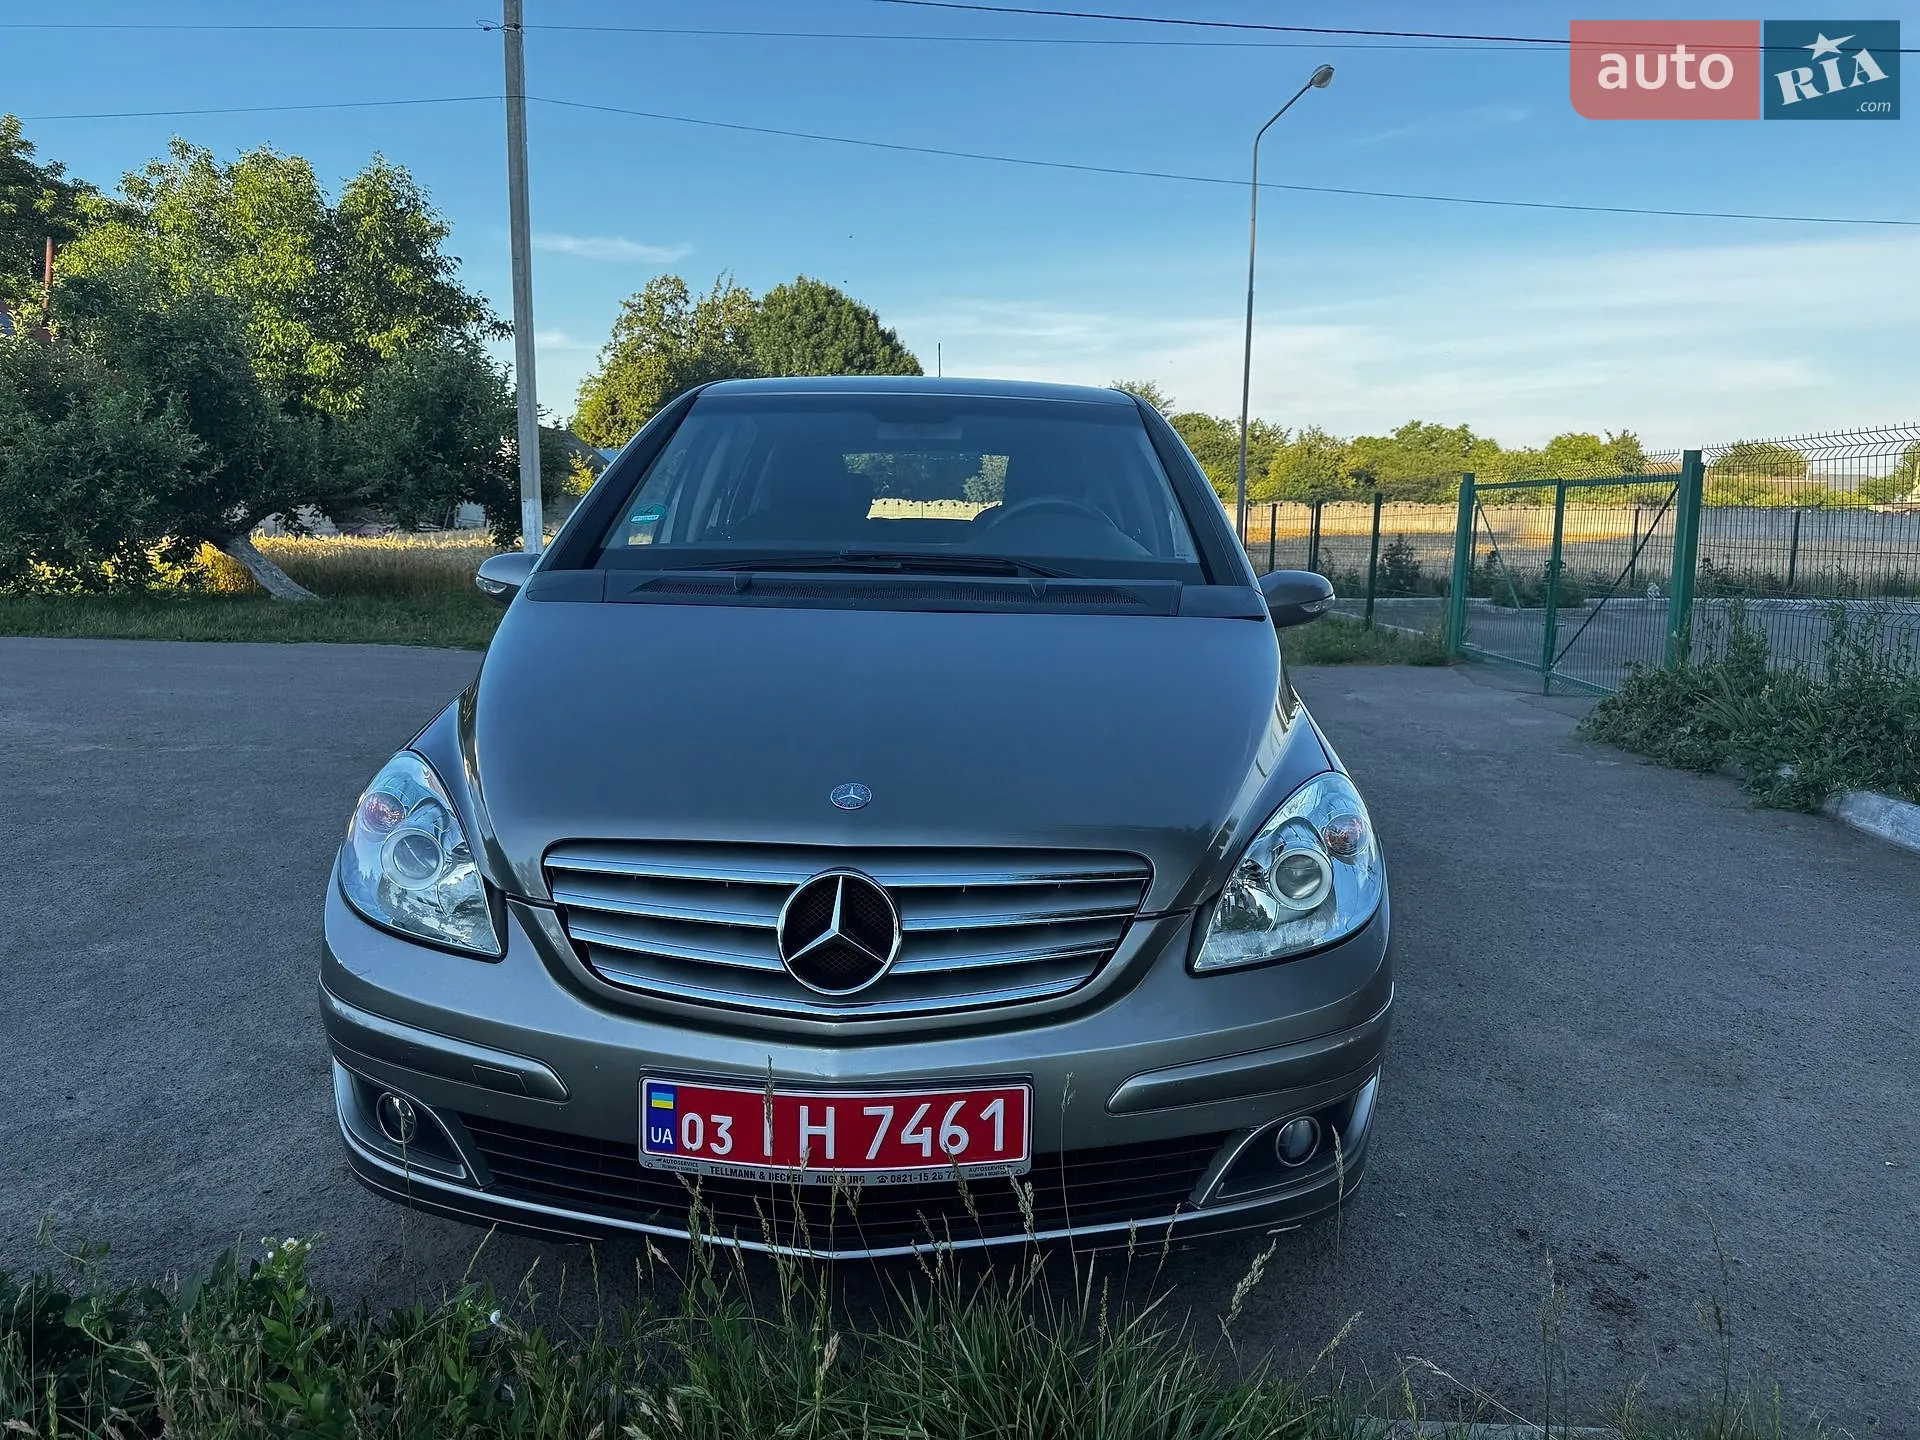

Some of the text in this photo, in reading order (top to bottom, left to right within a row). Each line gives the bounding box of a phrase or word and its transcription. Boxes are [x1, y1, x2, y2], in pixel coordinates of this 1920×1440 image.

[650, 1126, 674, 1145] UA
[681, 1112, 733, 1155] 03
[863, 1098, 1004, 1160] 7461
[662, 1158, 699, 1168] AUTOSERVICE
[709, 1166, 756, 1179] TELLMANN
[758, 1171, 766, 1180] &
